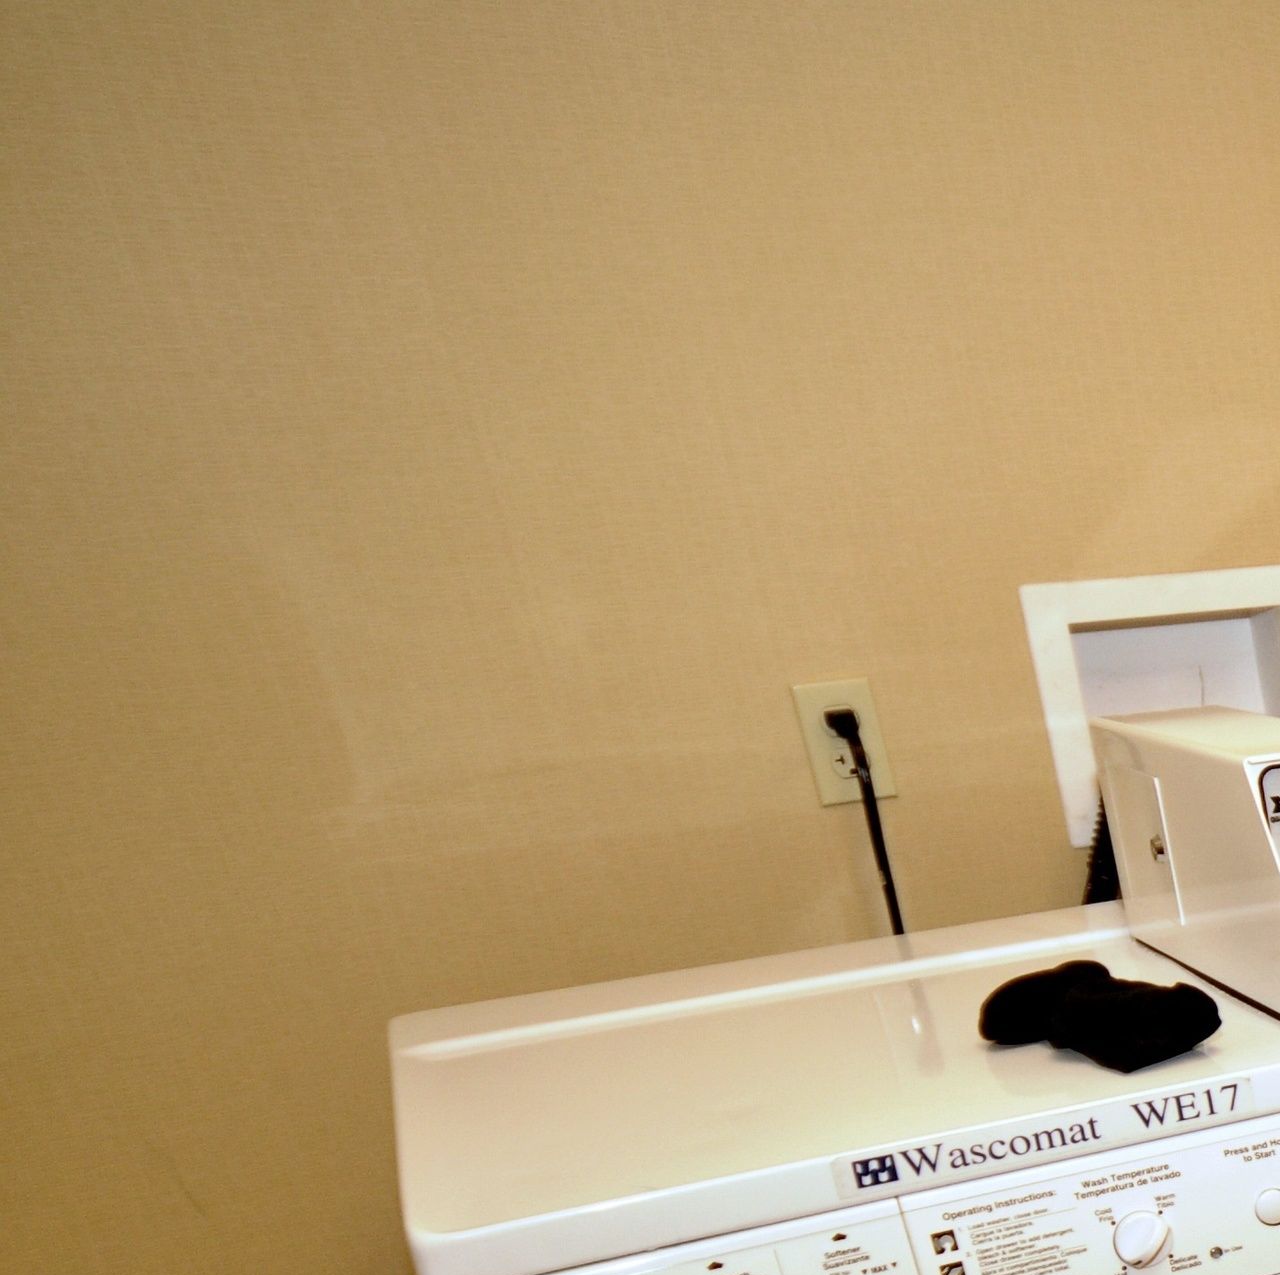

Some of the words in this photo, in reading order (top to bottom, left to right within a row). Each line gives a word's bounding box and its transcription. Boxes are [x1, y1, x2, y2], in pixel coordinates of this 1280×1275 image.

[899, 1116, 1102, 1177] Wascomat
[1130, 1083, 1239, 1129] WE17
[1223, 1146, 1249, 1157] Press
[1251, 1142, 1268, 1151] and
[1254, 1149, 1276, 1160] Start
[1081, 1175, 1109, 1189] Wash
[1110, 1162, 1170, 1183] Temperature
[1074, 1180, 1135, 1201] Temperatura
[1137, 1176, 1149, 1186] de
[1150, 1169, 1182, 1184] lavado
[942, 1203, 993, 1221] Operating
[995, 1190, 1057, 1209] Instructions:
[824, 1246, 861, 1260] Softener
[822, 1254, 871, 1271] Suavizante
[870, 1264, 888, 1274] MAX
